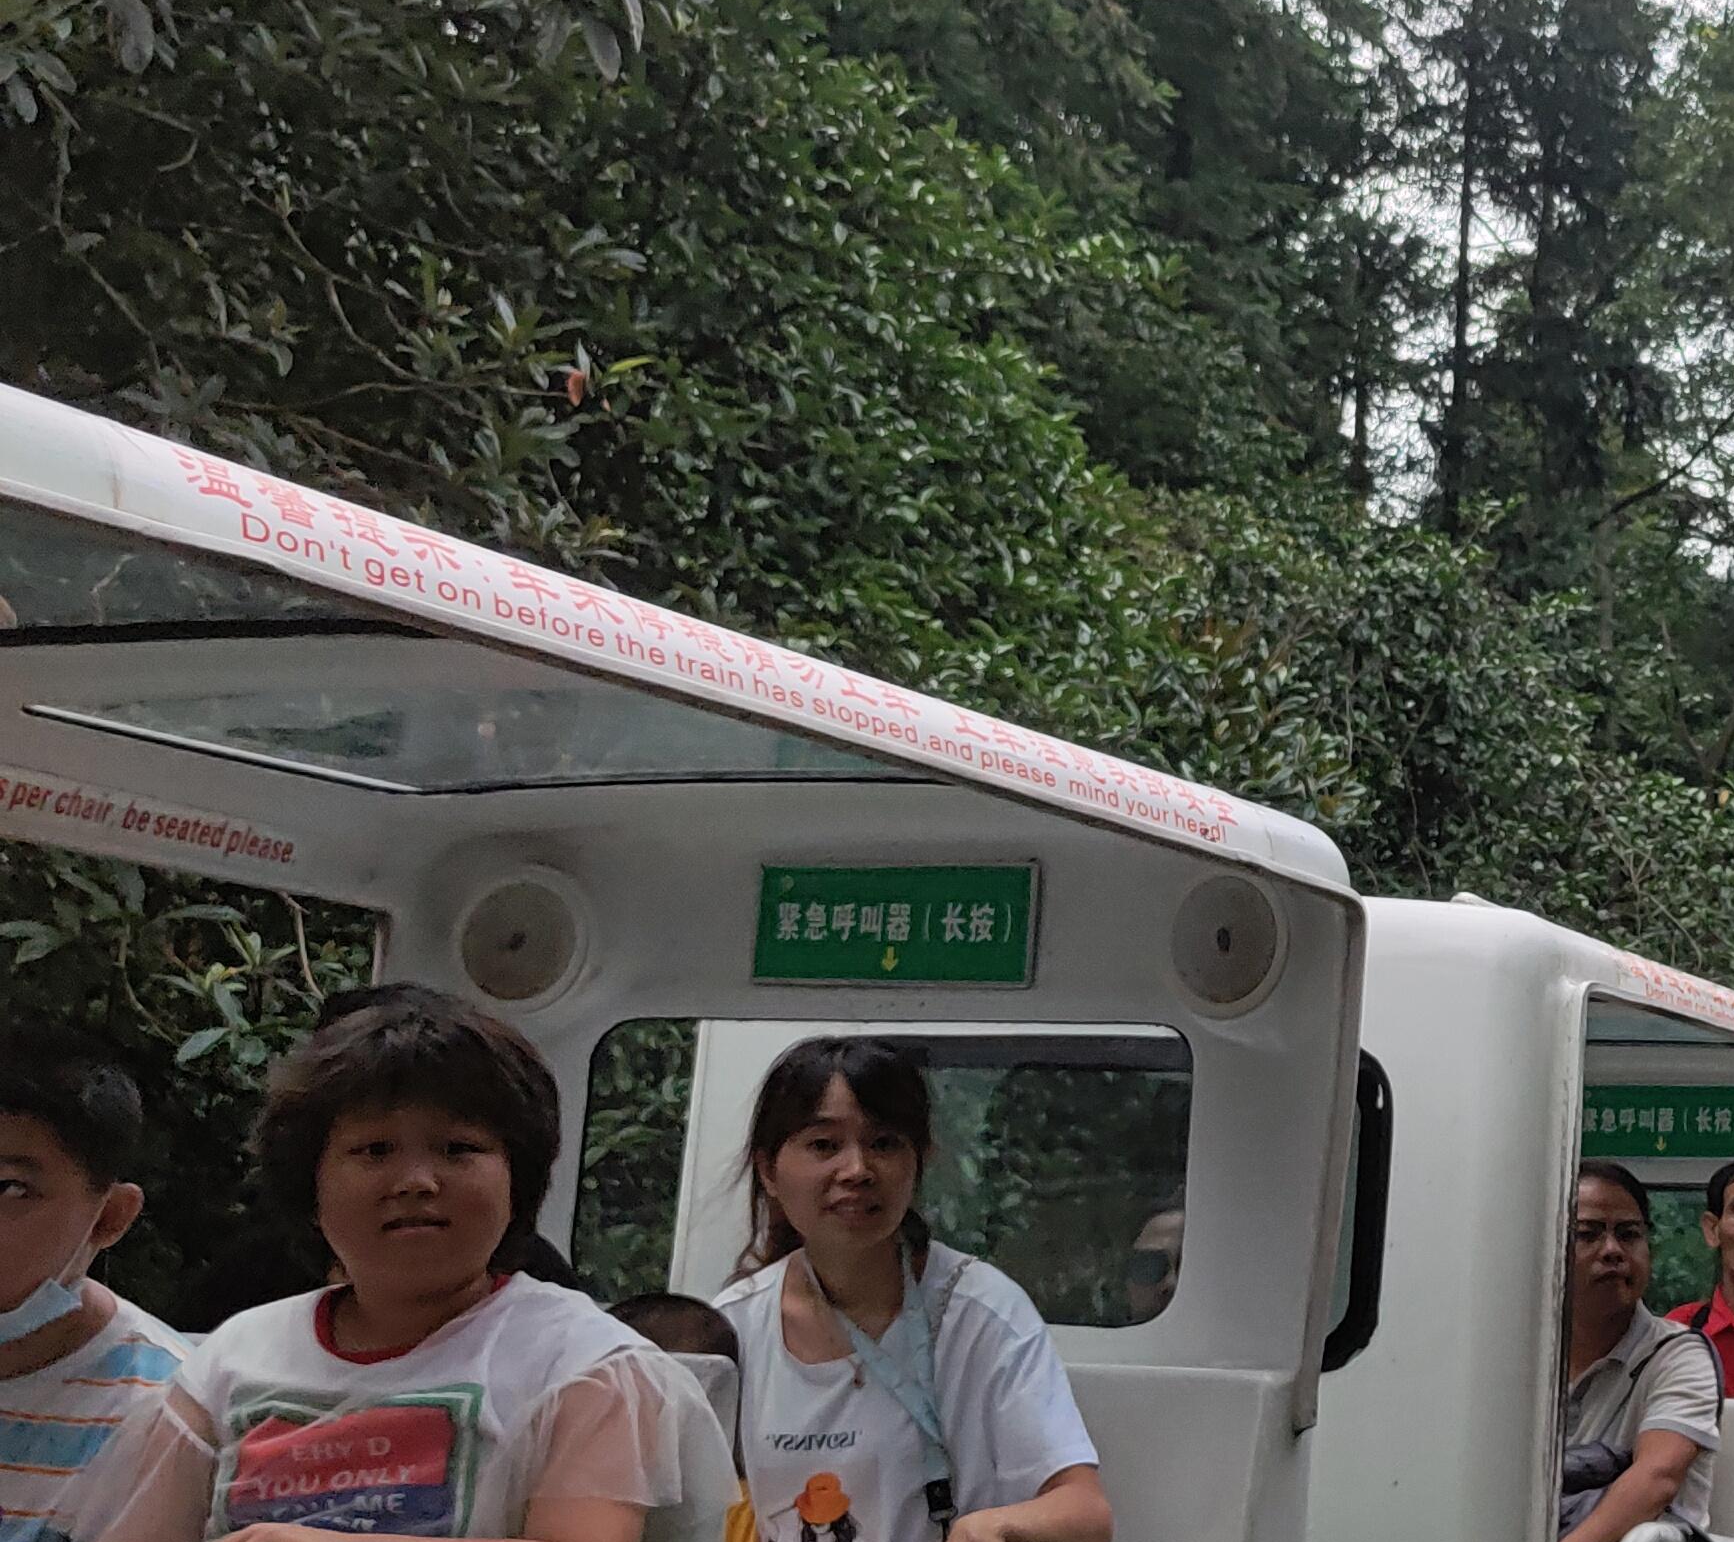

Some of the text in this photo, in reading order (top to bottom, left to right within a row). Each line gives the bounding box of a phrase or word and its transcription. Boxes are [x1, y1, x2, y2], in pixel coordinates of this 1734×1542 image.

[241, 512, 353, 571] Don't
[364, 557, 426, 594] get
[437, 580, 482, 610] on
[493, 591, 606, 648] before
[615, 633, 666, 665] the
[674, 651, 745, 691] train
[752, 674, 805, 708] has
[980, 749, 1057, 789] please
[1068, 778, 1120, 809] mind
[1124, 796, 1169, 823] your
[9, 780, 53, 811] per
[121, 800, 151, 832] be
[152, 813, 229, 850] seated
[251, 1463, 417, 1501] YOU ONLY
